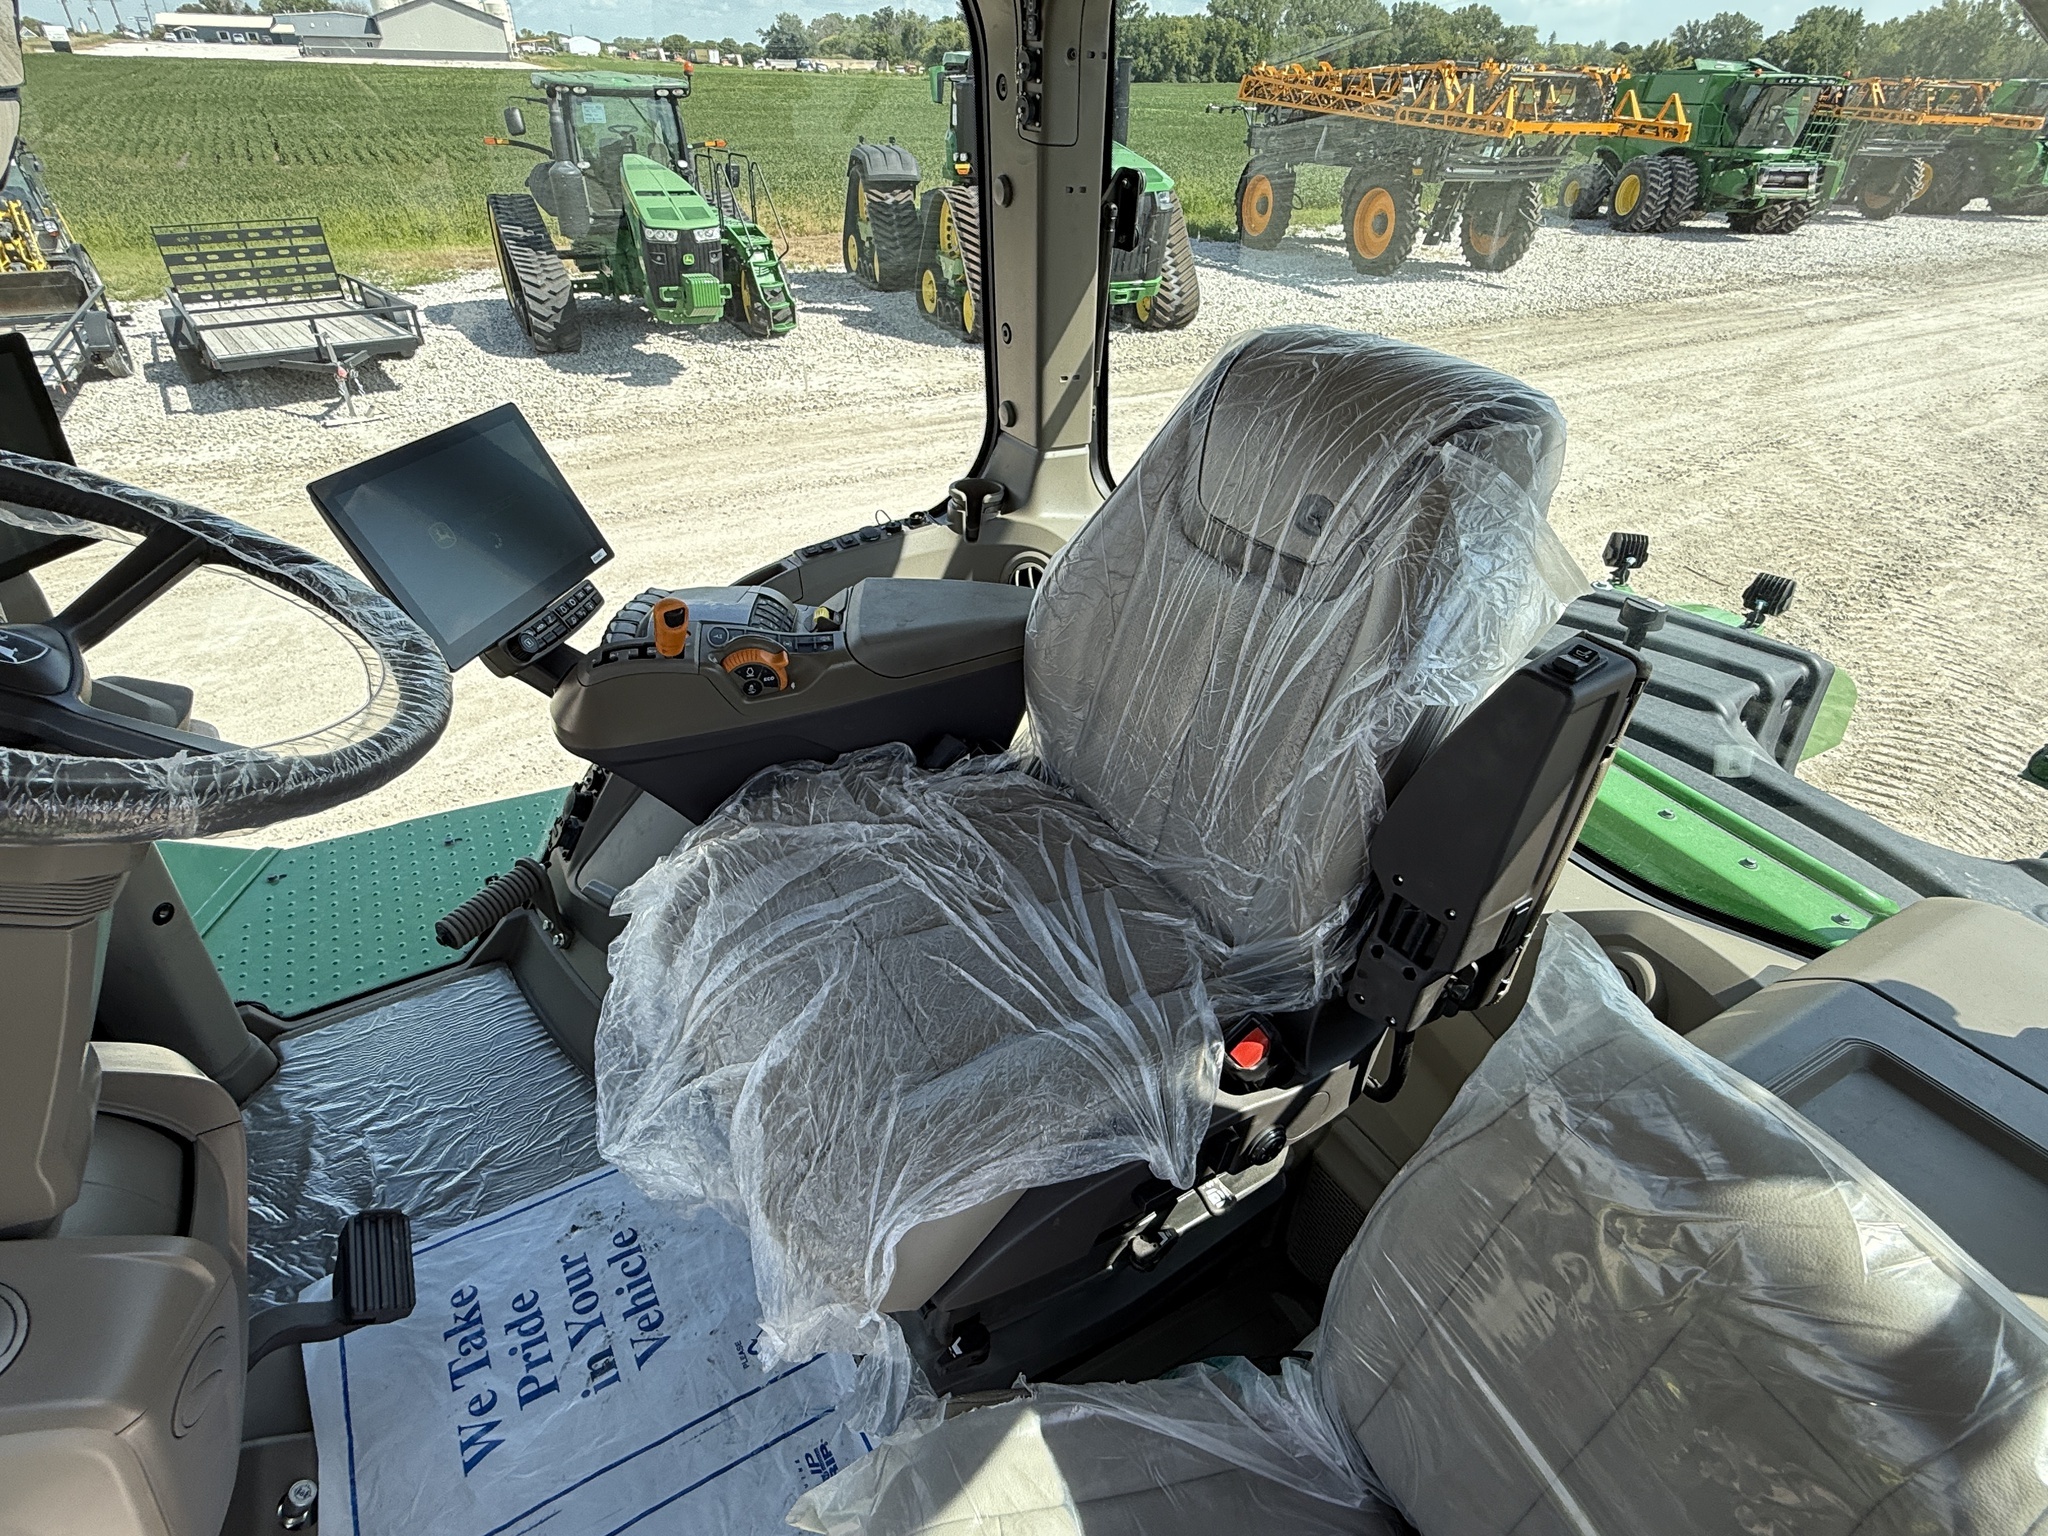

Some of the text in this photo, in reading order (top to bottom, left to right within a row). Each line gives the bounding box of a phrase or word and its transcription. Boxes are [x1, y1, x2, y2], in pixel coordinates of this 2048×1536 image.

[503, 1289, 560, 1411] Pride
[560, 1252, 622, 1395] in Your
[607, 1227, 671, 1371] Vehicle
[734, 1340, 750, 1370] PLEASE
[443, 1285, 506, 1477] We Take
